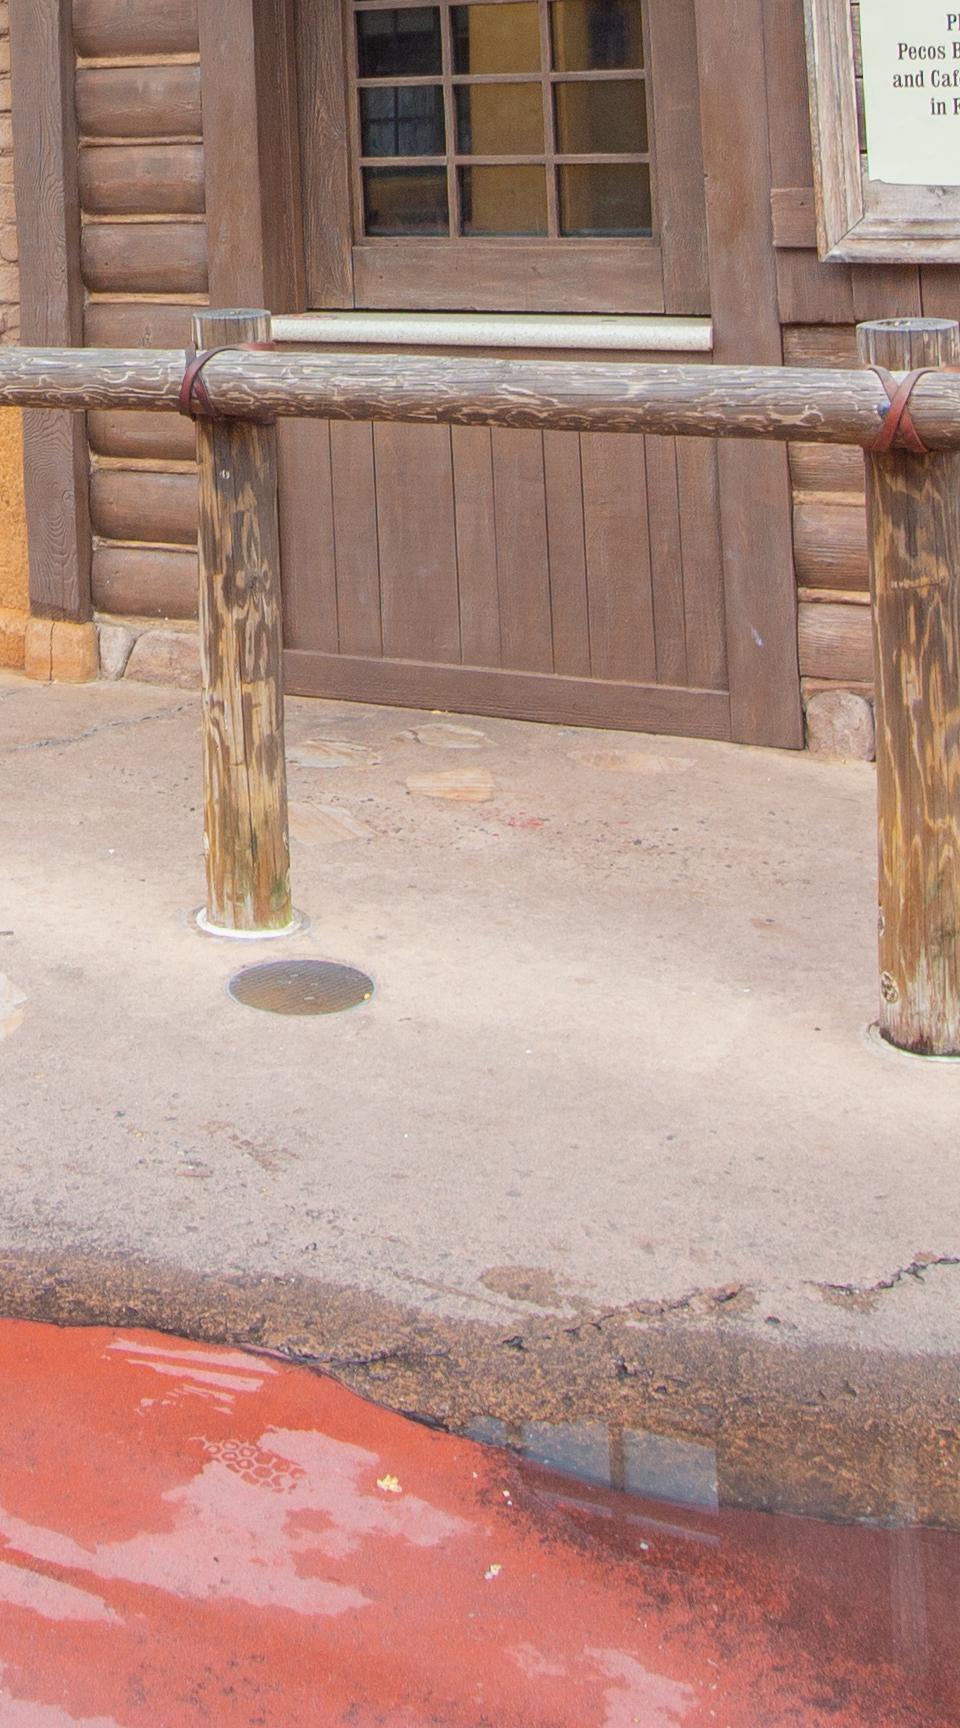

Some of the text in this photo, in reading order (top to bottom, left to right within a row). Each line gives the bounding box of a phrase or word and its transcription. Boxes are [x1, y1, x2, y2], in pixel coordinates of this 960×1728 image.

[897, 42, 946, 61] Pecos
[892, 68, 960, 89] and Caf
[930, 96, 947, 116] in
